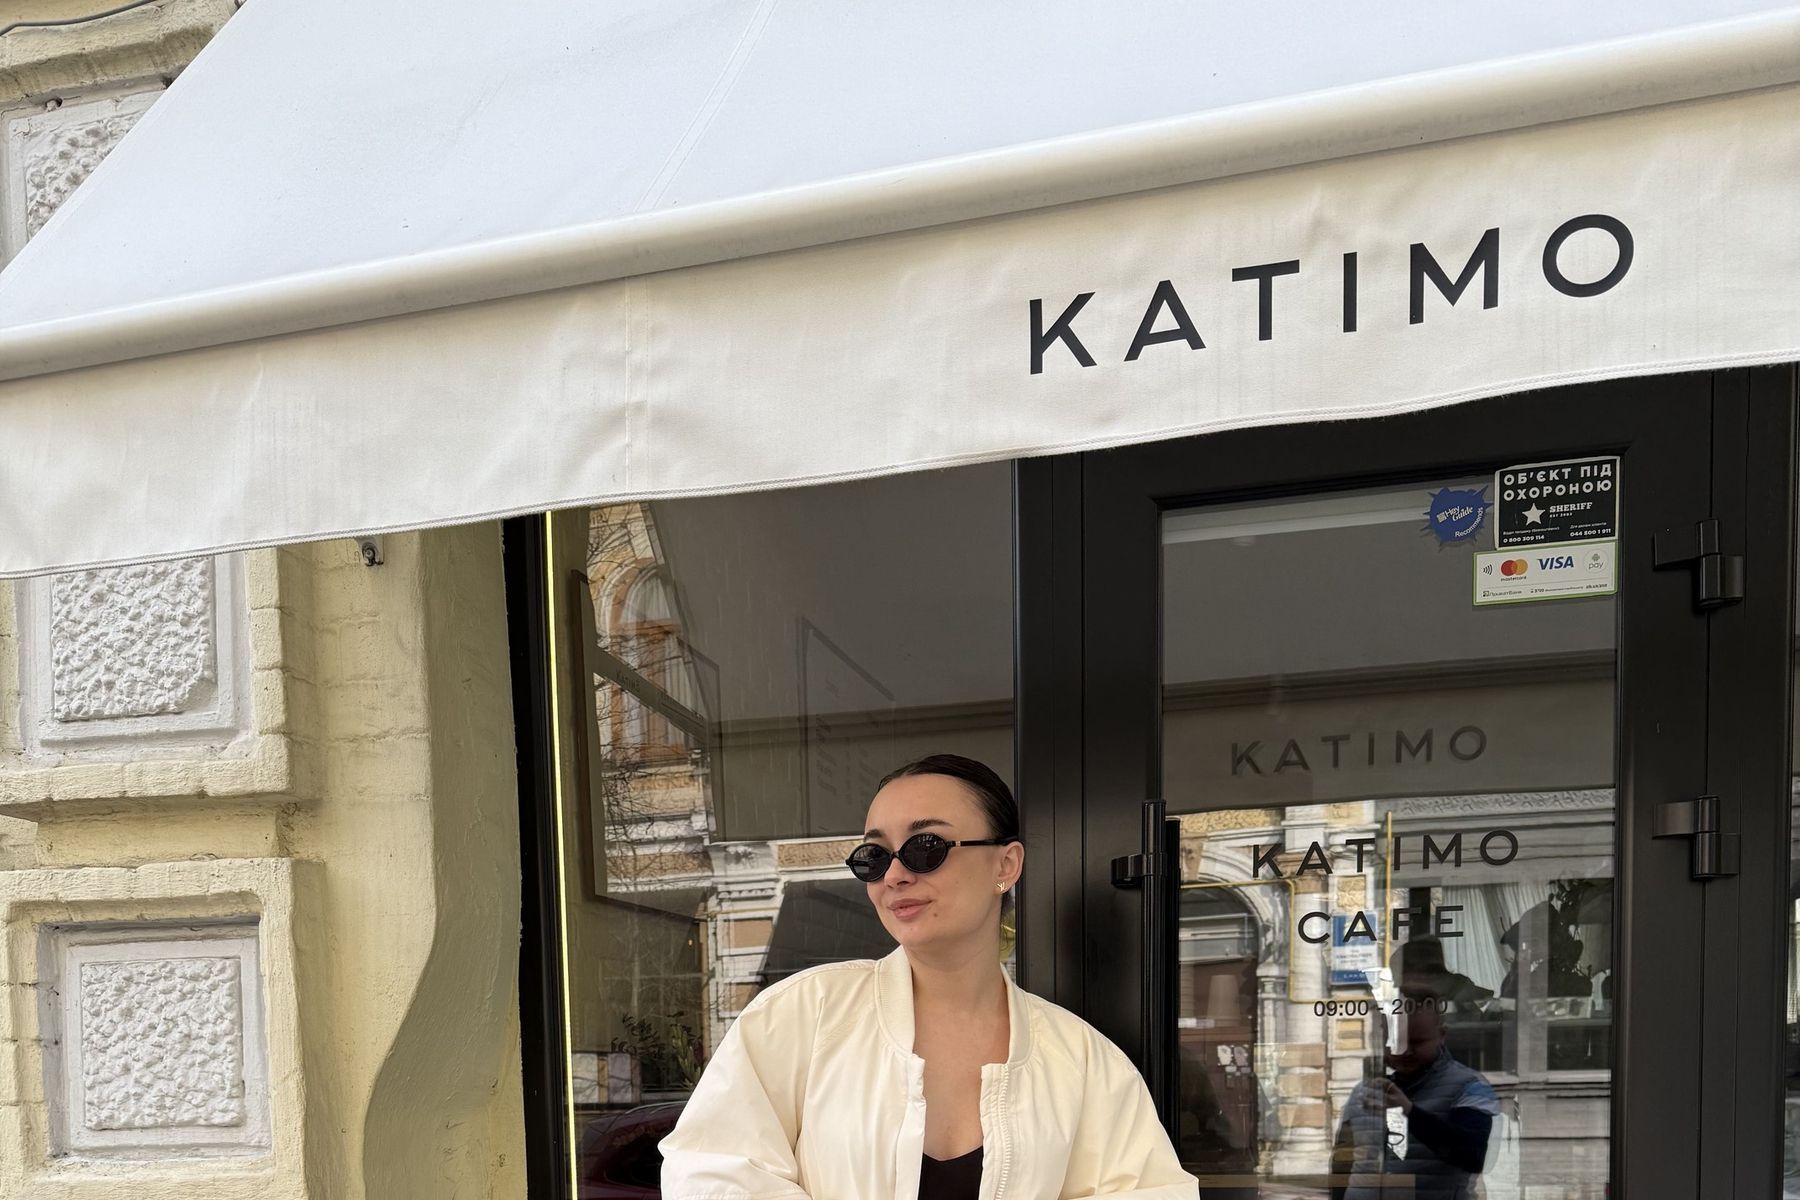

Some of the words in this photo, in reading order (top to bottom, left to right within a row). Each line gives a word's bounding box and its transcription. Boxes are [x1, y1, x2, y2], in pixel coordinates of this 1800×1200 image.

[1029, 213, 1635, 375] KATIMO
[1503, 468, 1571, 486] ОБ'ЄКТ
[1580, 463, 1612, 478] ПІД
[1503, 479, 1612, 501] ОХОРОНОЮ
[1452, 506, 1473, 522] Guide
[1549, 502, 1593, 513] SHERIFF
[1454, 506, 1484, 537] Recommends
[1537, 556, 1575, 571] VISA
[1588, 561, 1604, 570] pay
[1231, 725, 1487, 777] KATIMO
[1252, 830, 1519, 878] KATIMO
[1298, 905, 1464, 944] CAFE
[1314, 1000, 1369, 1017] 09:00
[1391, 997, 1448, 1015] 20:00
